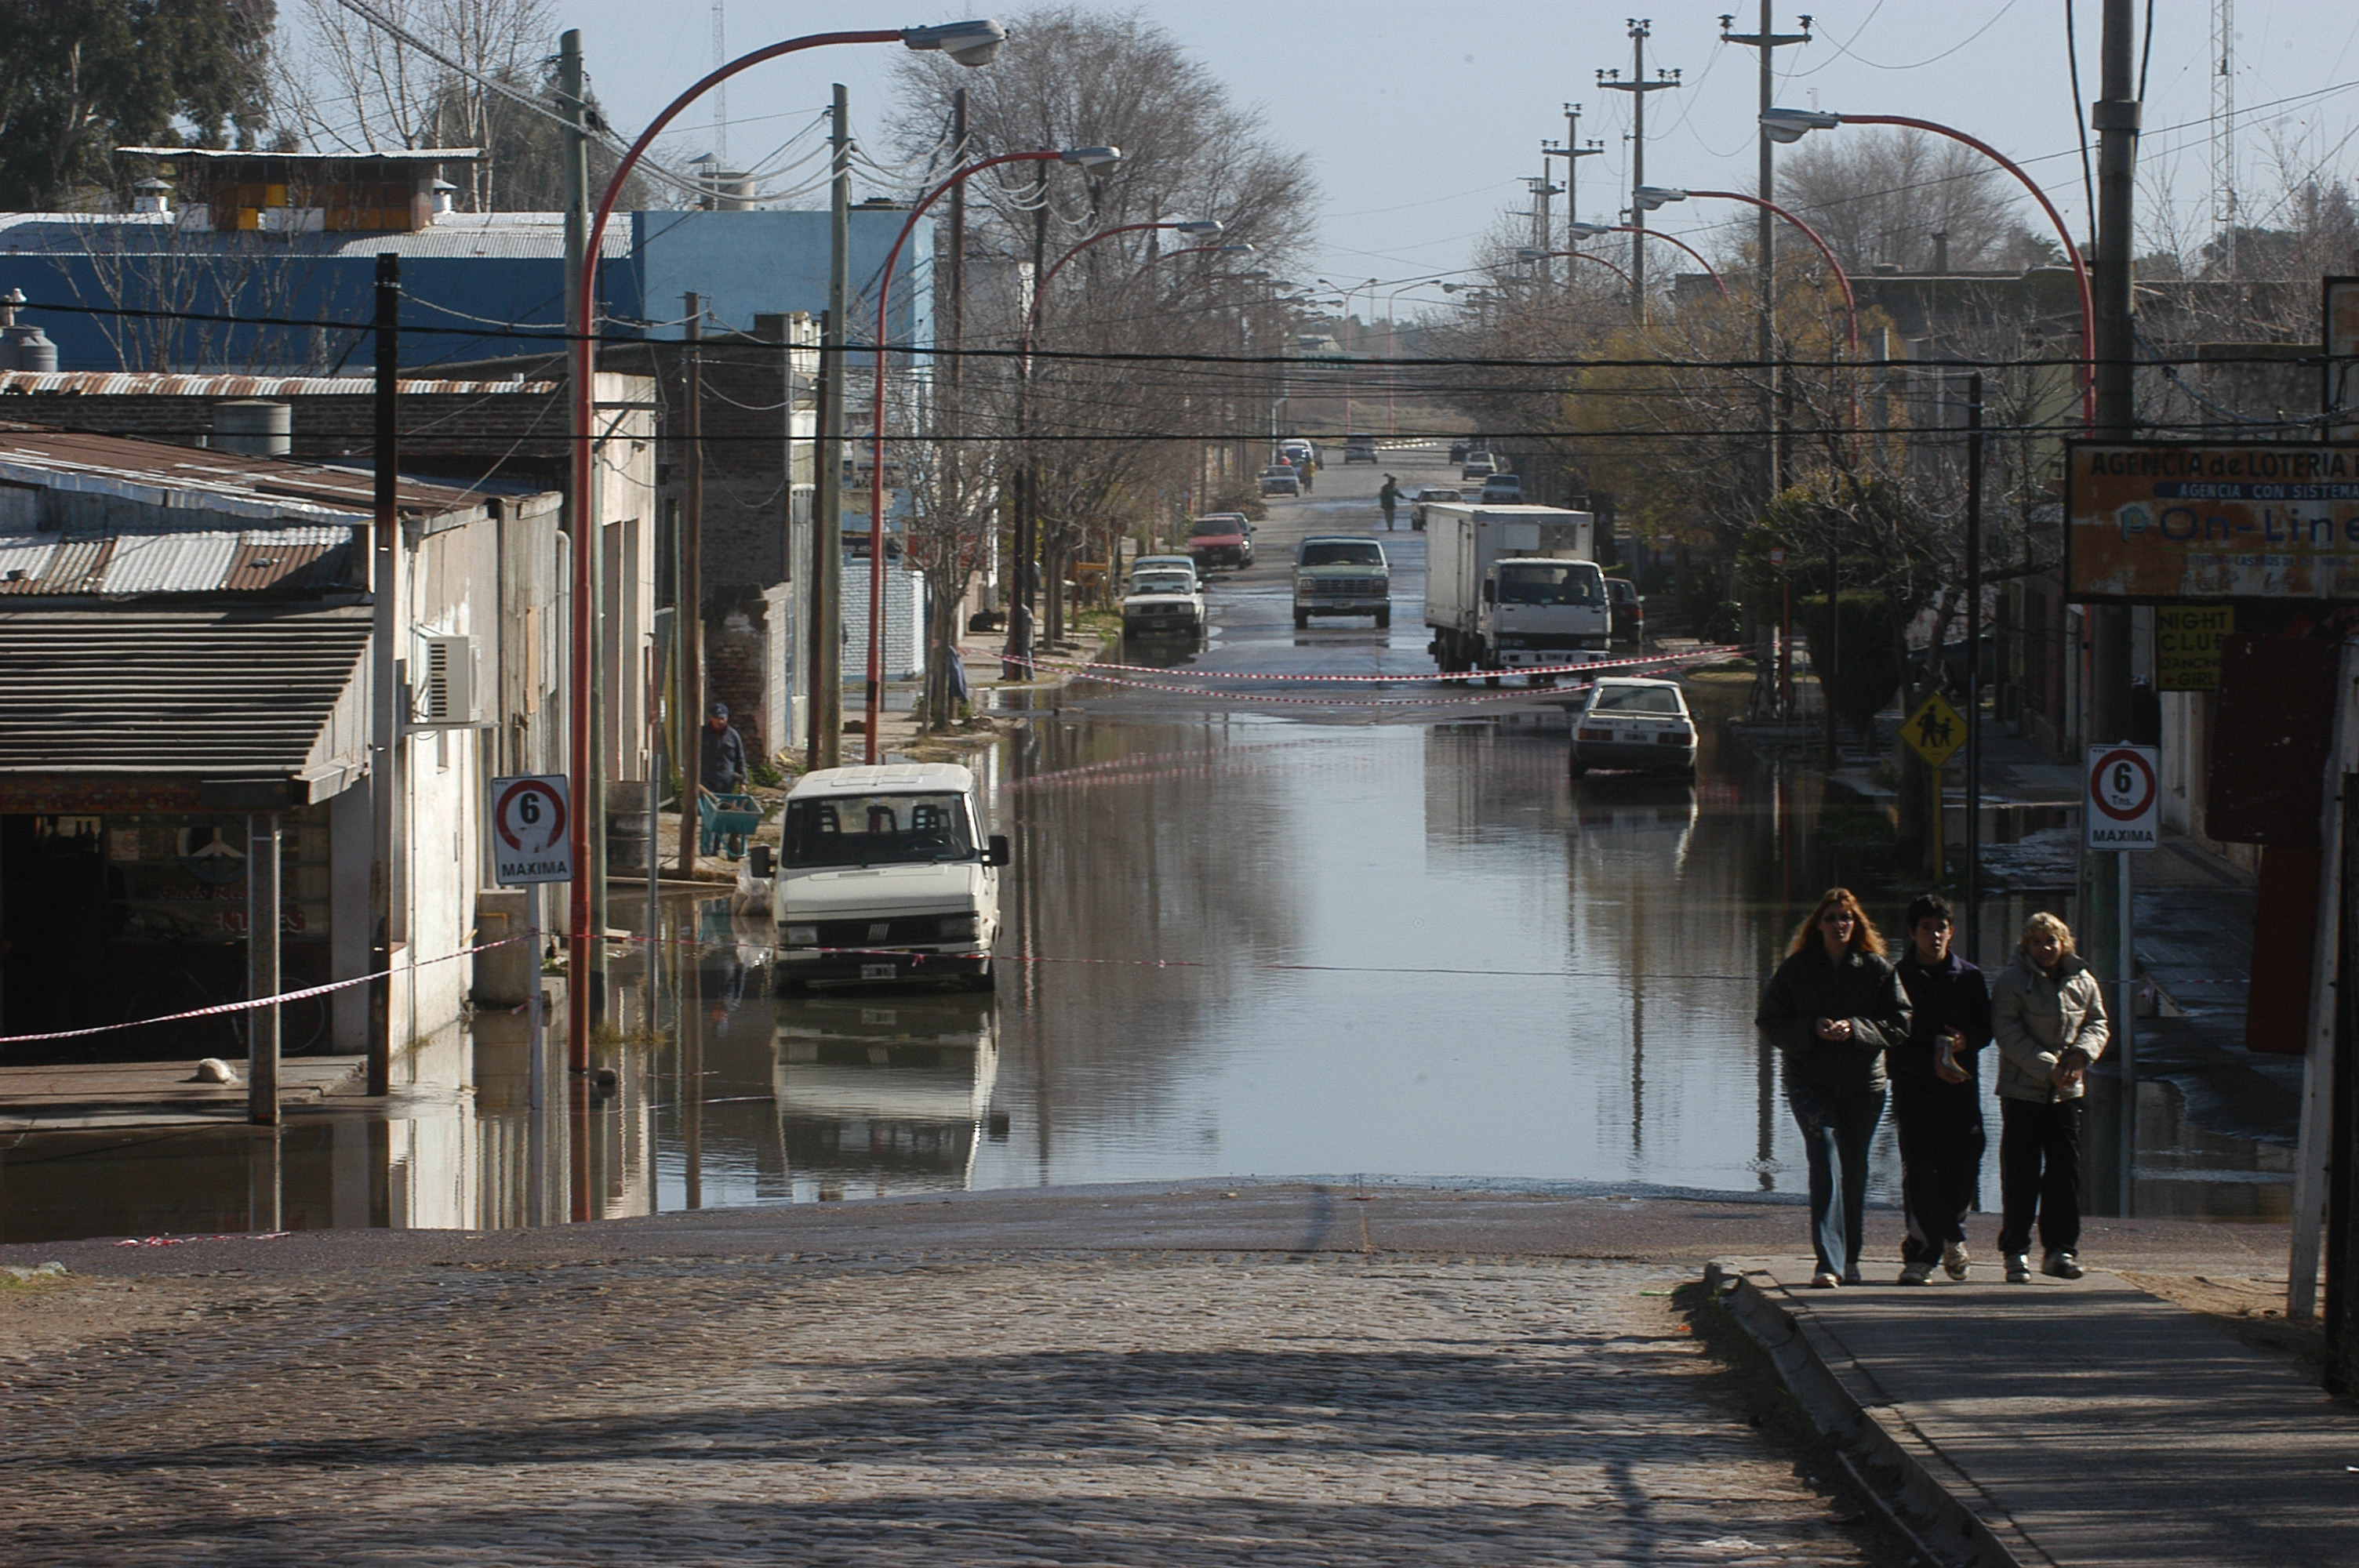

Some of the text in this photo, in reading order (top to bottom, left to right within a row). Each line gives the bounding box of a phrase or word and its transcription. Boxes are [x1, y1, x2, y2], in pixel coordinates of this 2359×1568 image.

[2090, 451, 2205, 477] AGENCIA
[2209, 452, 2243, 477] de
[2248, 452, 2345, 478] LOTERIA
[2179, 483, 2241, 497] AGENCIA
[2252, 483, 2285, 498] CON
[2158, 612, 2227, 630] NIGHT
[2114, 762, 2132, 793] 6
[520, 792, 540, 824] 6
[2092, 829, 2154, 842] MAXIMA
[502, 862, 568, 877] MAXIMA
